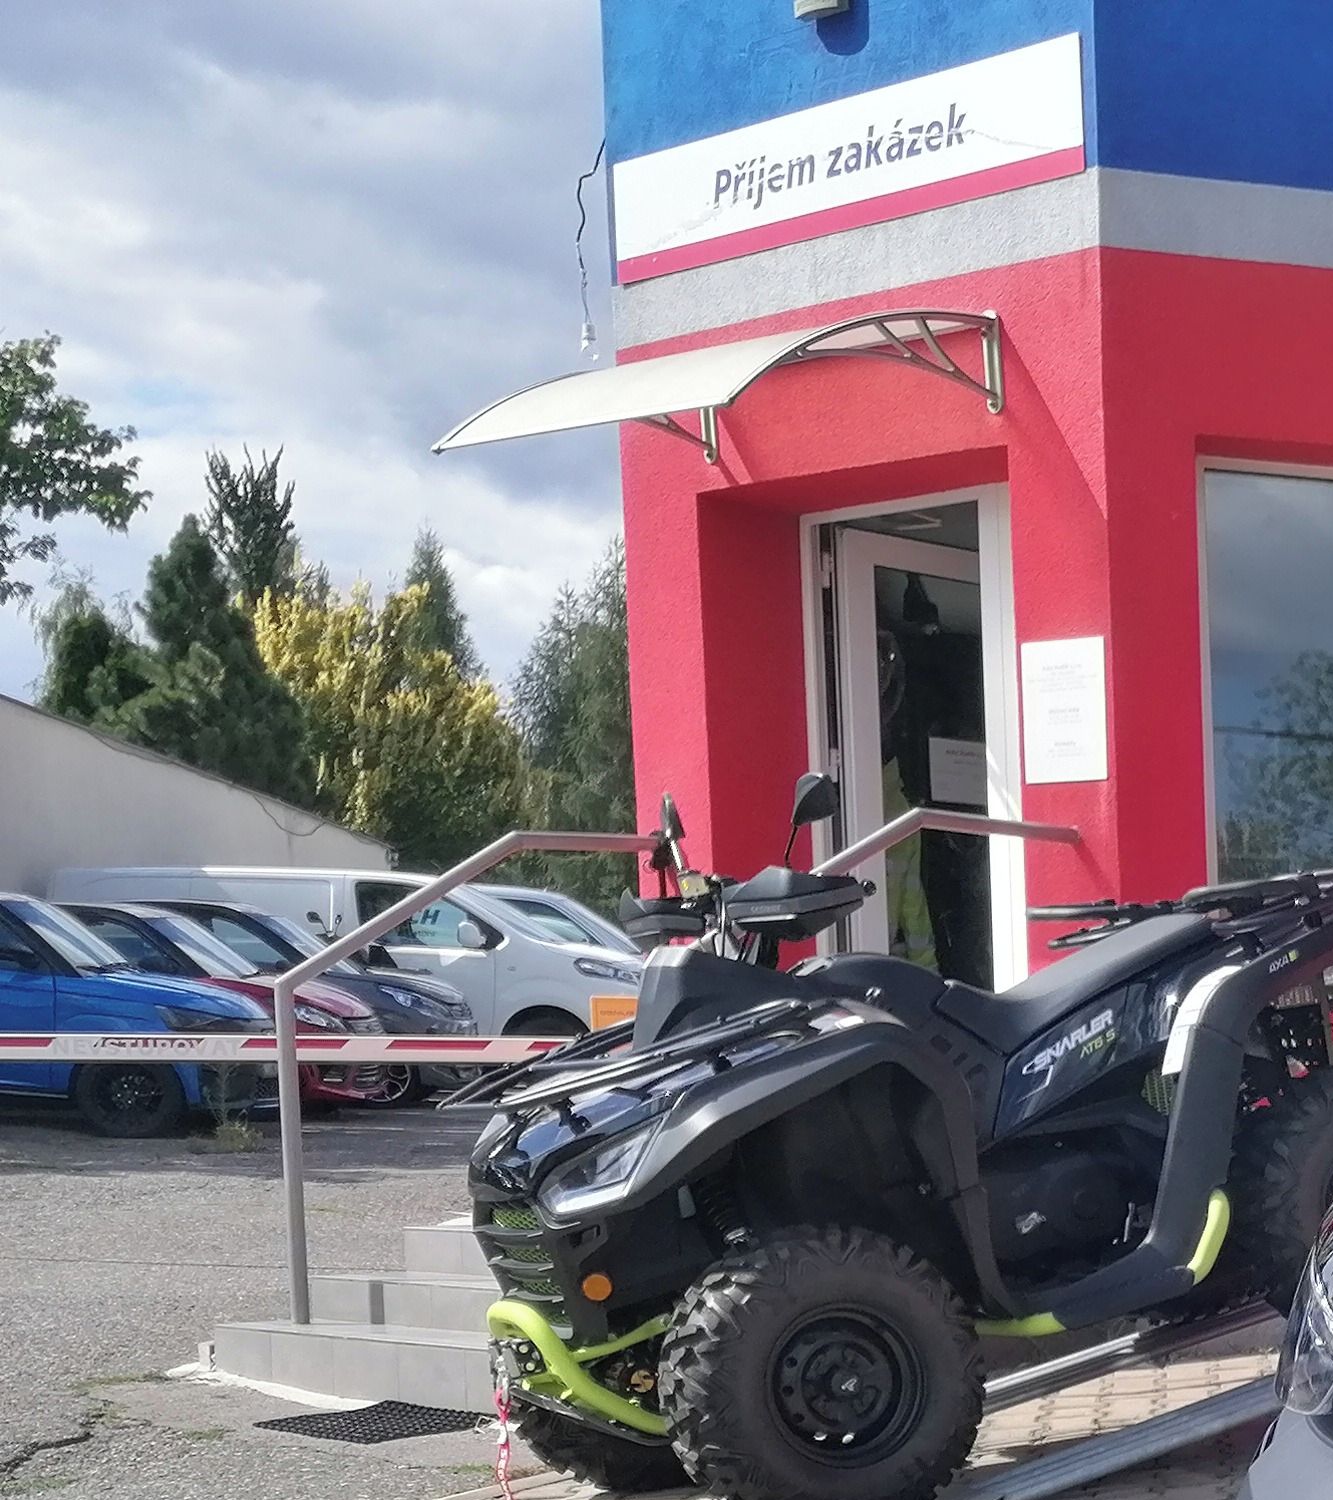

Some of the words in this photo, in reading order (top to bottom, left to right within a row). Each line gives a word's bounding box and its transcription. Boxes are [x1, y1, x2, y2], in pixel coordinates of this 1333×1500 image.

[713, 155, 815, 209] Příjem
[826, 103, 967, 178] zakázek
[1022, 1008, 1113, 1075] SNARLER
